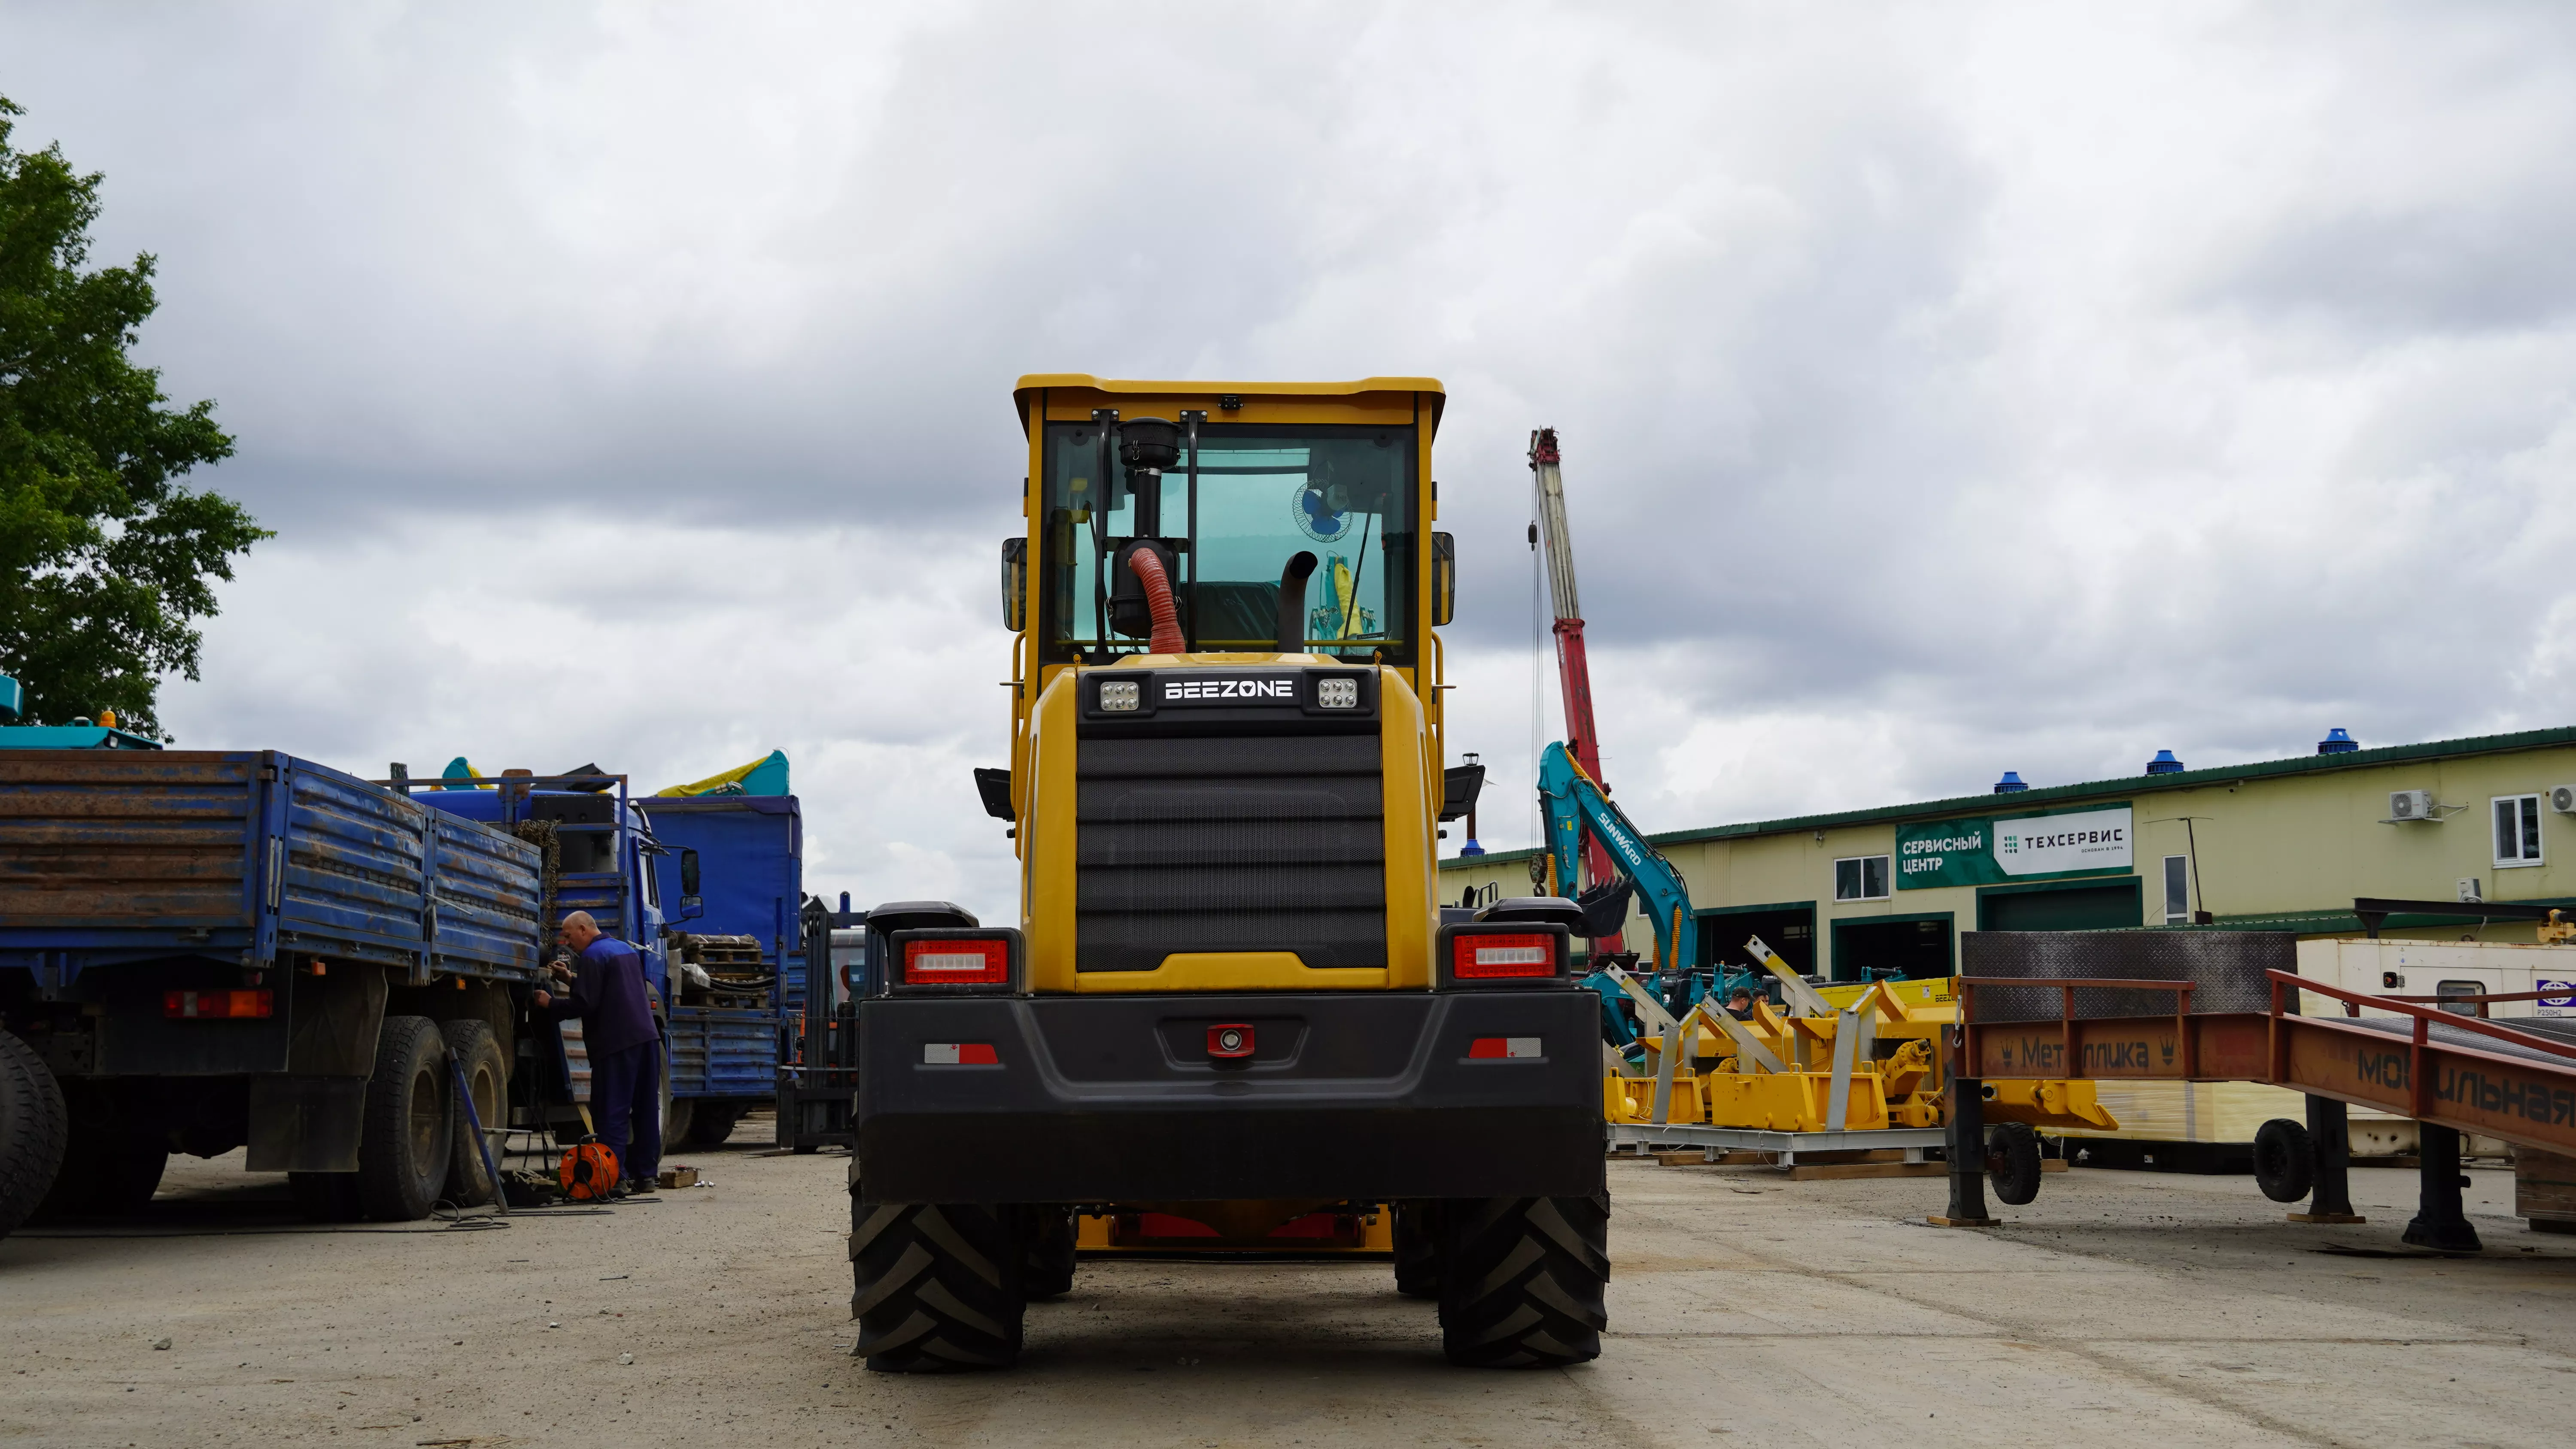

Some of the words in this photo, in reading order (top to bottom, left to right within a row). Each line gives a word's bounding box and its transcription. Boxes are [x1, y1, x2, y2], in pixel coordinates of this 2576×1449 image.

[1165, 680, 1293, 699] BEEZONE
[1598, 812, 1641, 866] SUNWARD
[1903, 831, 1981, 855] СЕРВИСНЫЙ
[2025, 829, 2123, 849] ТЕХСЕРВИС
[1903, 857, 1943, 875] ЦЕНТР
[2022, 1036, 2149, 1068] Метллика
